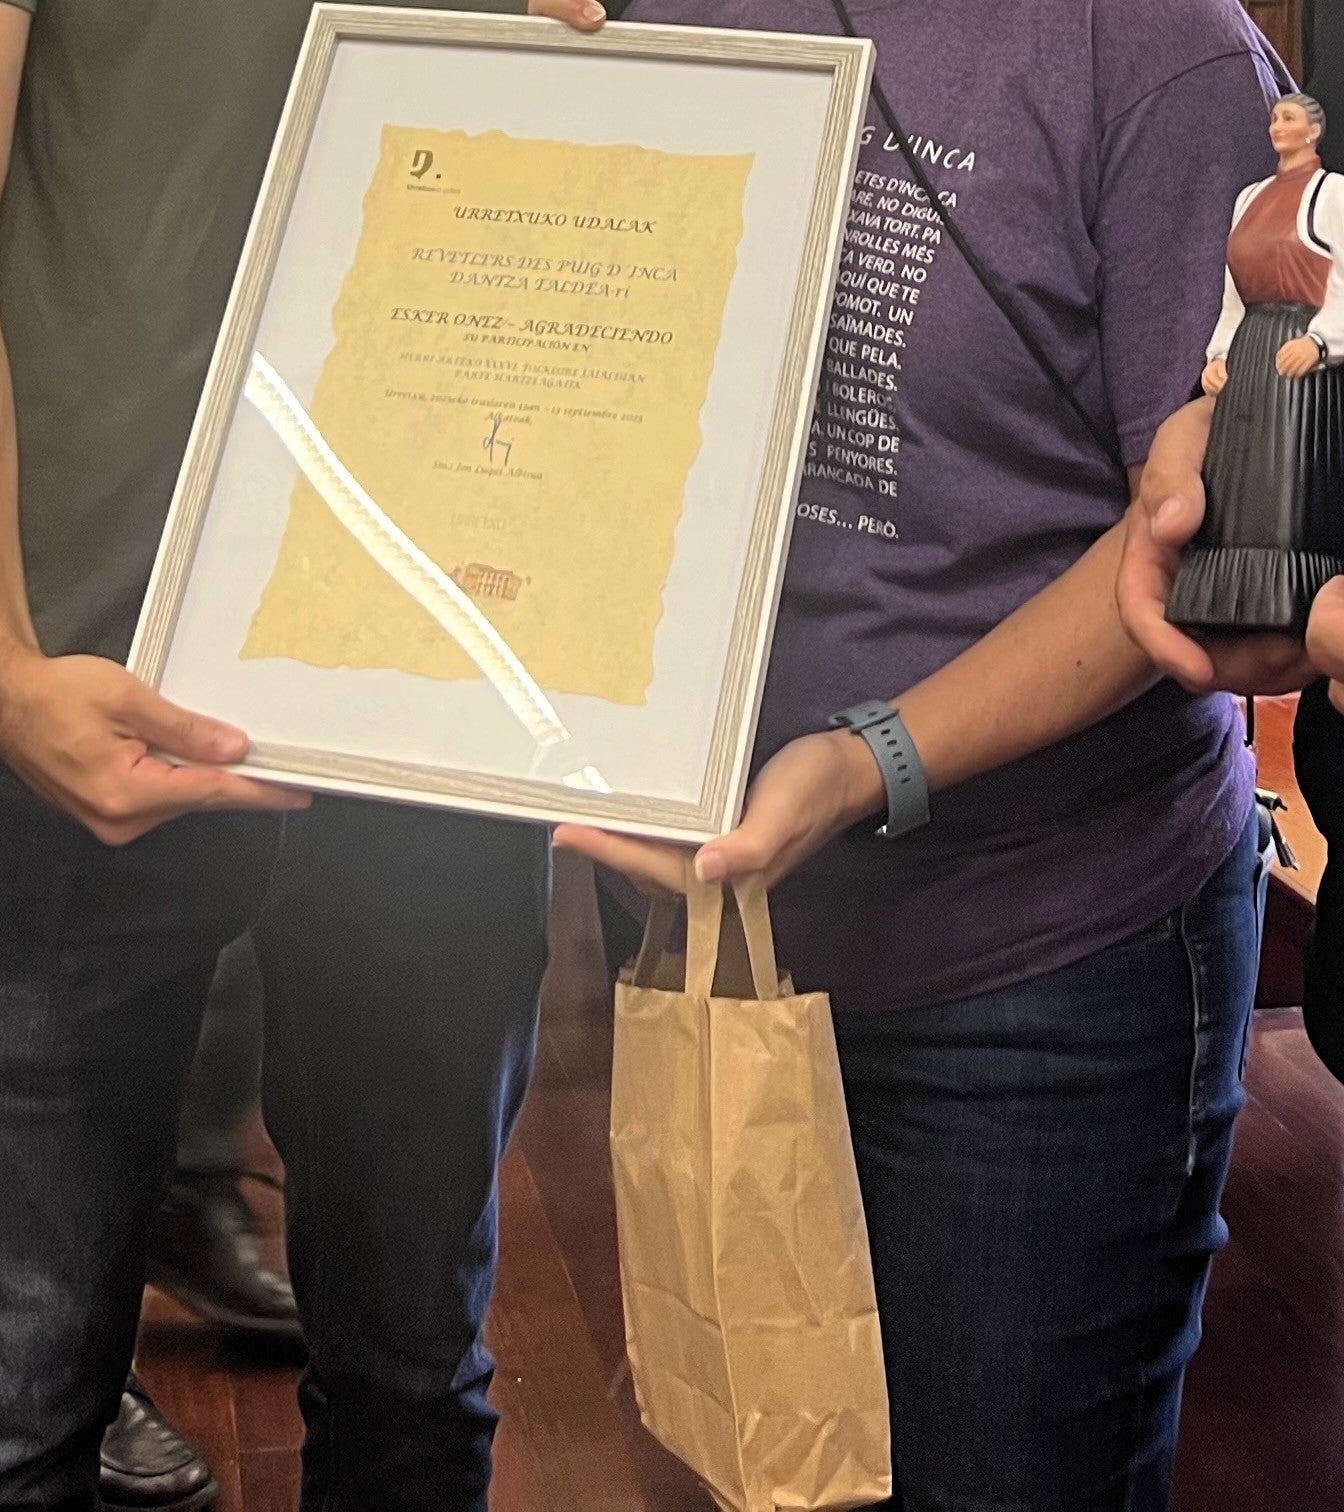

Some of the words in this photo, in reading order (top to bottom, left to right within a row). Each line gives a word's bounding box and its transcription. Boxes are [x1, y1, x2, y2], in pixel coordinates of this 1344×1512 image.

[876, 196, 899, 212] NO
[454, 206, 567, 226] URRETXUKO
[573, 215, 656, 234] UDALAK
[883, 216, 921, 239] TORT.
[922, 226, 941, 244] PA
[411, 247, 514, 268] REVETLERS
[517, 255, 553, 271] DES
[557, 260, 602, 278] PUIG
[859, 252, 895, 276] VERD.
[901, 264, 927, 283] NO
[901, 243, 935, 264] MÉS
[449, 271, 529, 290] DANTZA
[867, 277, 900, 299] QUE
[902, 285, 920, 305] TE
[390, 307, 449, 324] ESKER
[454, 313, 505, 329] ONEZ
[519, 319, 674, 345] AGRADECIENDO
[889, 305, 913, 325] UN
[463, 333, 478, 342] SU
[572, 343, 592, 353] EN
[829, 337, 857, 357] QUE
[861, 344, 901, 370] PELA.
[827, 358, 897, 391] BALLADES.
[827, 422, 846, 440] UN
[848, 429, 874, 448] COP
[878, 435, 900, 453] DE
[827, 444, 898, 475] PENYORES.
[878, 479, 898, 497] DE
